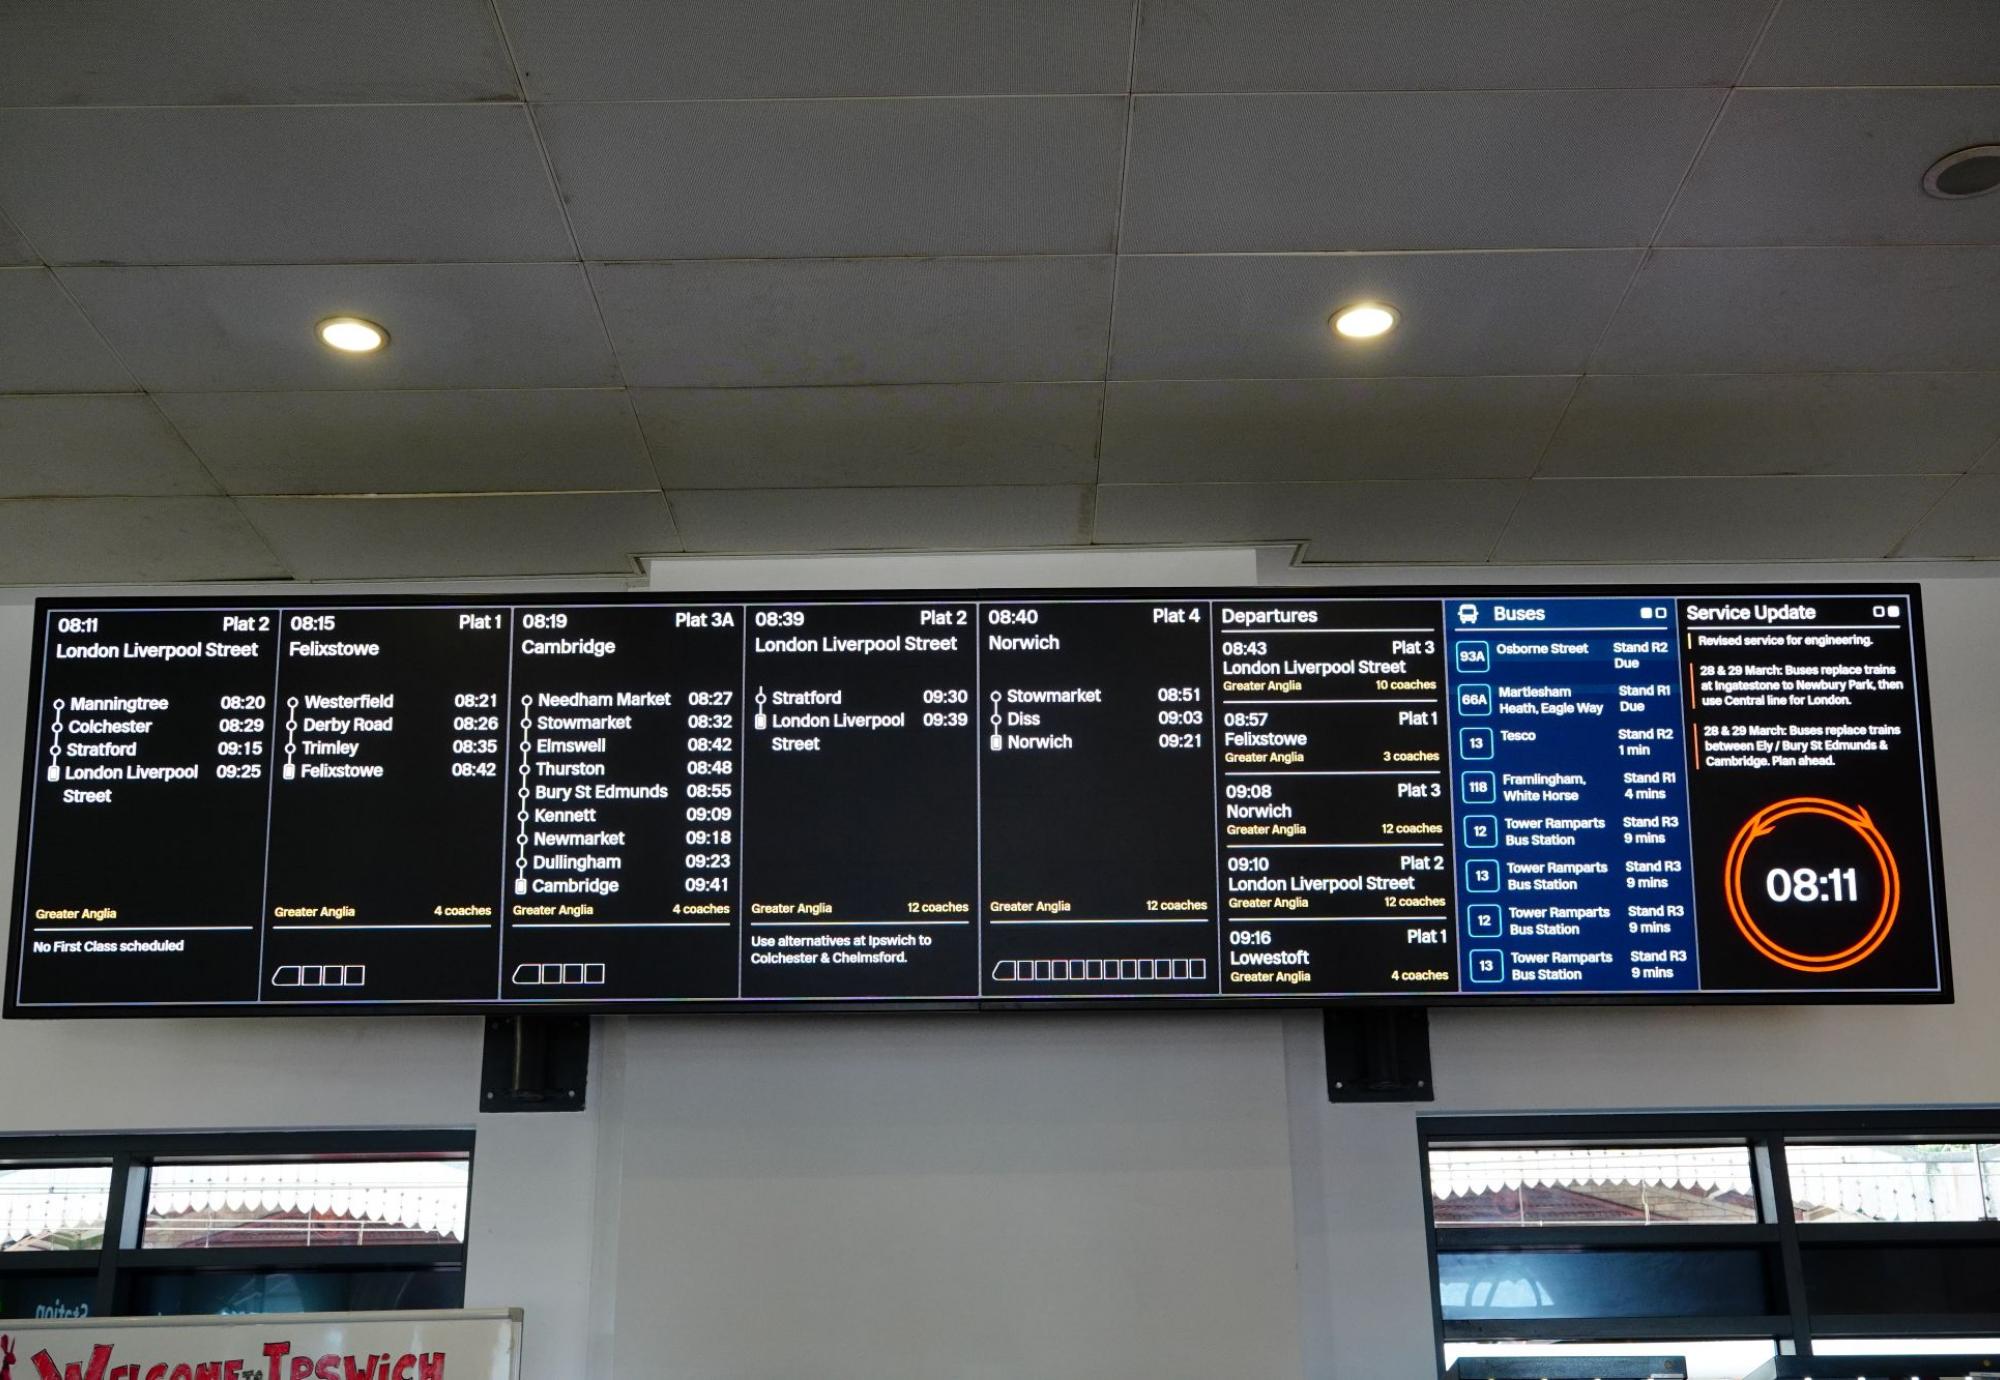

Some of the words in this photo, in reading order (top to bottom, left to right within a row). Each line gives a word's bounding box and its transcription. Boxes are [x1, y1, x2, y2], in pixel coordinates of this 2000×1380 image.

[676, 612, 708, 627] Plat
[711, 612, 734, 627] 3A
[756, 612, 804, 626] 08:39
[921, 610, 952, 625] Plat
[957, 610, 967, 625] 2
[989, 609, 1038, 624] 08:40
[1153, 608, 1185, 623] Plat
[1189, 608, 1200, 622] 4
[1222, 608, 1318, 626] Departures
[1494, 606, 1545, 621] Buses
[1687, 605, 1751, 620] Service
[1754, 604, 1816, 622] Update
[58, 618, 98, 633] 08:11
[223, 616, 255, 631] Plat
[259, 616, 269, 631] 2
[291, 616, 335, 631] 08:15
[460, 614, 491, 629] Plat
[495, 615, 501, 629] 1
[523, 614, 567, 629] 08:19
[522, 638, 615, 657] Cambridge
[756, 637, 818, 652] London
[823, 636, 900, 654] Liverpool
[905, 636, 957, 650] Street
[989, 634, 1059, 650] Norwich
[1393, 640, 1421, 654] Plat
[1425, 641, 1435, 654] 3
[1613, 642, 1649, 652] Stand
[1652, 642, 1668, 652] R2
[1698, 635, 1742, 645] Revised
[1744, 635, 1785, 645] service
[1786, 635, 1803, 645] for
[1804, 634, 1873, 647] engineering.
[57, 643, 119, 658] London
[124, 642, 202, 660] Liverpool
[205, 642, 259, 657] Street
[290, 641, 379, 656] Felixstowe
[1222, 642, 1267, 655] 08:43
[1496, 643, 1549, 654] Osborne
[1551, 643, 1589, 654] Street
[1460, 651, 1485, 662] 93A
[1614, 658, 1639, 668] Due
[1223, 660, 1280, 674] London
[1284, 660, 1355, 677] Liverpool
[1359, 660, 1406, 673] Street
[1700, 666, 1715, 676] 28
[1717, 665, 1726, 675] &
[1728, 665, 1743, 675] 29
[1745, 664, 1783, 675] March:
[1785, 665, 1819, 675] Buses
[1821, 664, 1862, 677] replace
[1864, 664, 1896, 674] trains
[1223, 681, 1266, 691] Greater
[1268, 680, 1302, 693] Anglia
[1376, 680, 1388, 689] 10
[1391, 679, 1436, 689] coaches
[1619, 685, 1654, 696] Stand
[1657, 685, 1670, 696] R1
[1701, 681, 1713, 691] at
[1715, 681, 1780, 693] Ingatestone
[1781, 681, 1794, 690] to
[1796, 679, 1847, 692] Newbury
[1848, 679, 1876, 690] Park,
[1877, 679, 1904, 689] then
[1008, 688, 1101, 703] Stowmarket
[1158, 688, 1200, 701] 08:51
[1499, 686, 1571, 697] Martlesham
[71, 696, 169, 713] Manningtree
[305, 694, 394, 708] Westerfield
[455, 694, 496, 707] 08:21
[538, 692, 613, 706] Needham
[617, 692, 671, 706] Market
[1462, 694, 1487, 705] 66A
[1620, 701, 1645, 711] Due
[1702, 697, 1722, 705] use
[1724, 695, 1765, 705] Central
[1767, 695, 1787, 705] line
[1789, 694, 1805, 705] for
[1807, 694, 1852, 705] London.
[1499, 703, 1539, 714] Heath,
[1541, 702, 1575, 716] Eagle
[1576, 703, 1603, 715] Way
[454, 717, 498, 730] 08:26
[537, 715, 632, 730] Stowmarket
[1008, 711, 1040, 726] Diss
[1159, 711, 1203, 724] 09:03
[1224, 713, 1268, 726] 08:57
[1399, 711, 1428, 725] Plat
[1431, 711, 1437, 725] 1
[68, 719, 153, 733] Colchester
[304, 717, 350, 734] Derby
[354, 717, 393, 731] Road
[1225, 732, 1307, 746] Felixstowe
[1500, 730, 1536, 741] Tesco
[1618, 728, 1654, 739] Stand
[1657, 729, 1674, 739] R2
[453, 740, 497, 753] 08:35
[537, 738, 605, 753] Elmswell
[1008, 734, 1072, 749] Norwich
[1159, 734, 1201, 748] 09:21
[1470, 738, 1483, 748] 13
[67, 742, 137, 756] Stratford
[302, 740, 359, 757] Trimley
[1619, 745, 1624, 755] 1
[1627, 744, 1650, 755] min
[536, 762, 605, 776] Thurston
[536, 785, 572, 801] Bury
[575, 785, 592, 798] St
[595, 784, 668, 798] Edmunds
[535, 808, 596, 822] Kennett
[1623, 816, 1659, 827] Stand
[1662, 816, 1679, 827] R3
[1504, 818, 1543, 829] Tower
[1545, 818, 1605, 830] Ramparts
[534, 831, 625, 846] Newmarket
[1474, 826, 1487, 837] 12
[1624, 833, 1633, 843] 9
[1635, 832, 1666, 843] mins
[1506, 835, 1529, 846] Bus
[1531, 834, 1575, 845] Station
[534, 854, 621, 871] Dullingham
[1767, 868, 1857, 902] 08:11
[36, 909, 80, 919] Greater
[81, 908, 117, 921] Anglia
[274, 907, 318, 917] Greater
[320, 906, 355, 919] Anglia
[513, 905, 556, 915] Greater
[559, 904, 593, 917] Anglia
[673, 904, 681, 914] 4
[683, 904, 730, 914] coaches
[752, 936, 775, 946] Use
[778, 935, 851, 946] alternatives
[853, 935, 866, 946] at
[869, 934, 916, 948] Ipswich
[918, 935, 932, 945] to
[1230, 931, 1271, 944] 09:16
[1408, 929, 1437, 943] Plat
[1440, 929, 1446, 943] 1
[33, 942, 51, 952] No
[54, 941, 82, 952] First
[84, 941, 117, 952] Class
[120, 940, 184, 952] scheduled
[751, 952, 818, 964] Colchester
[820, 952, 830, 963] &
[833, 951, 907, 963] Chelmsford.
[1231, 950, 1309, 965] Lowestoft
